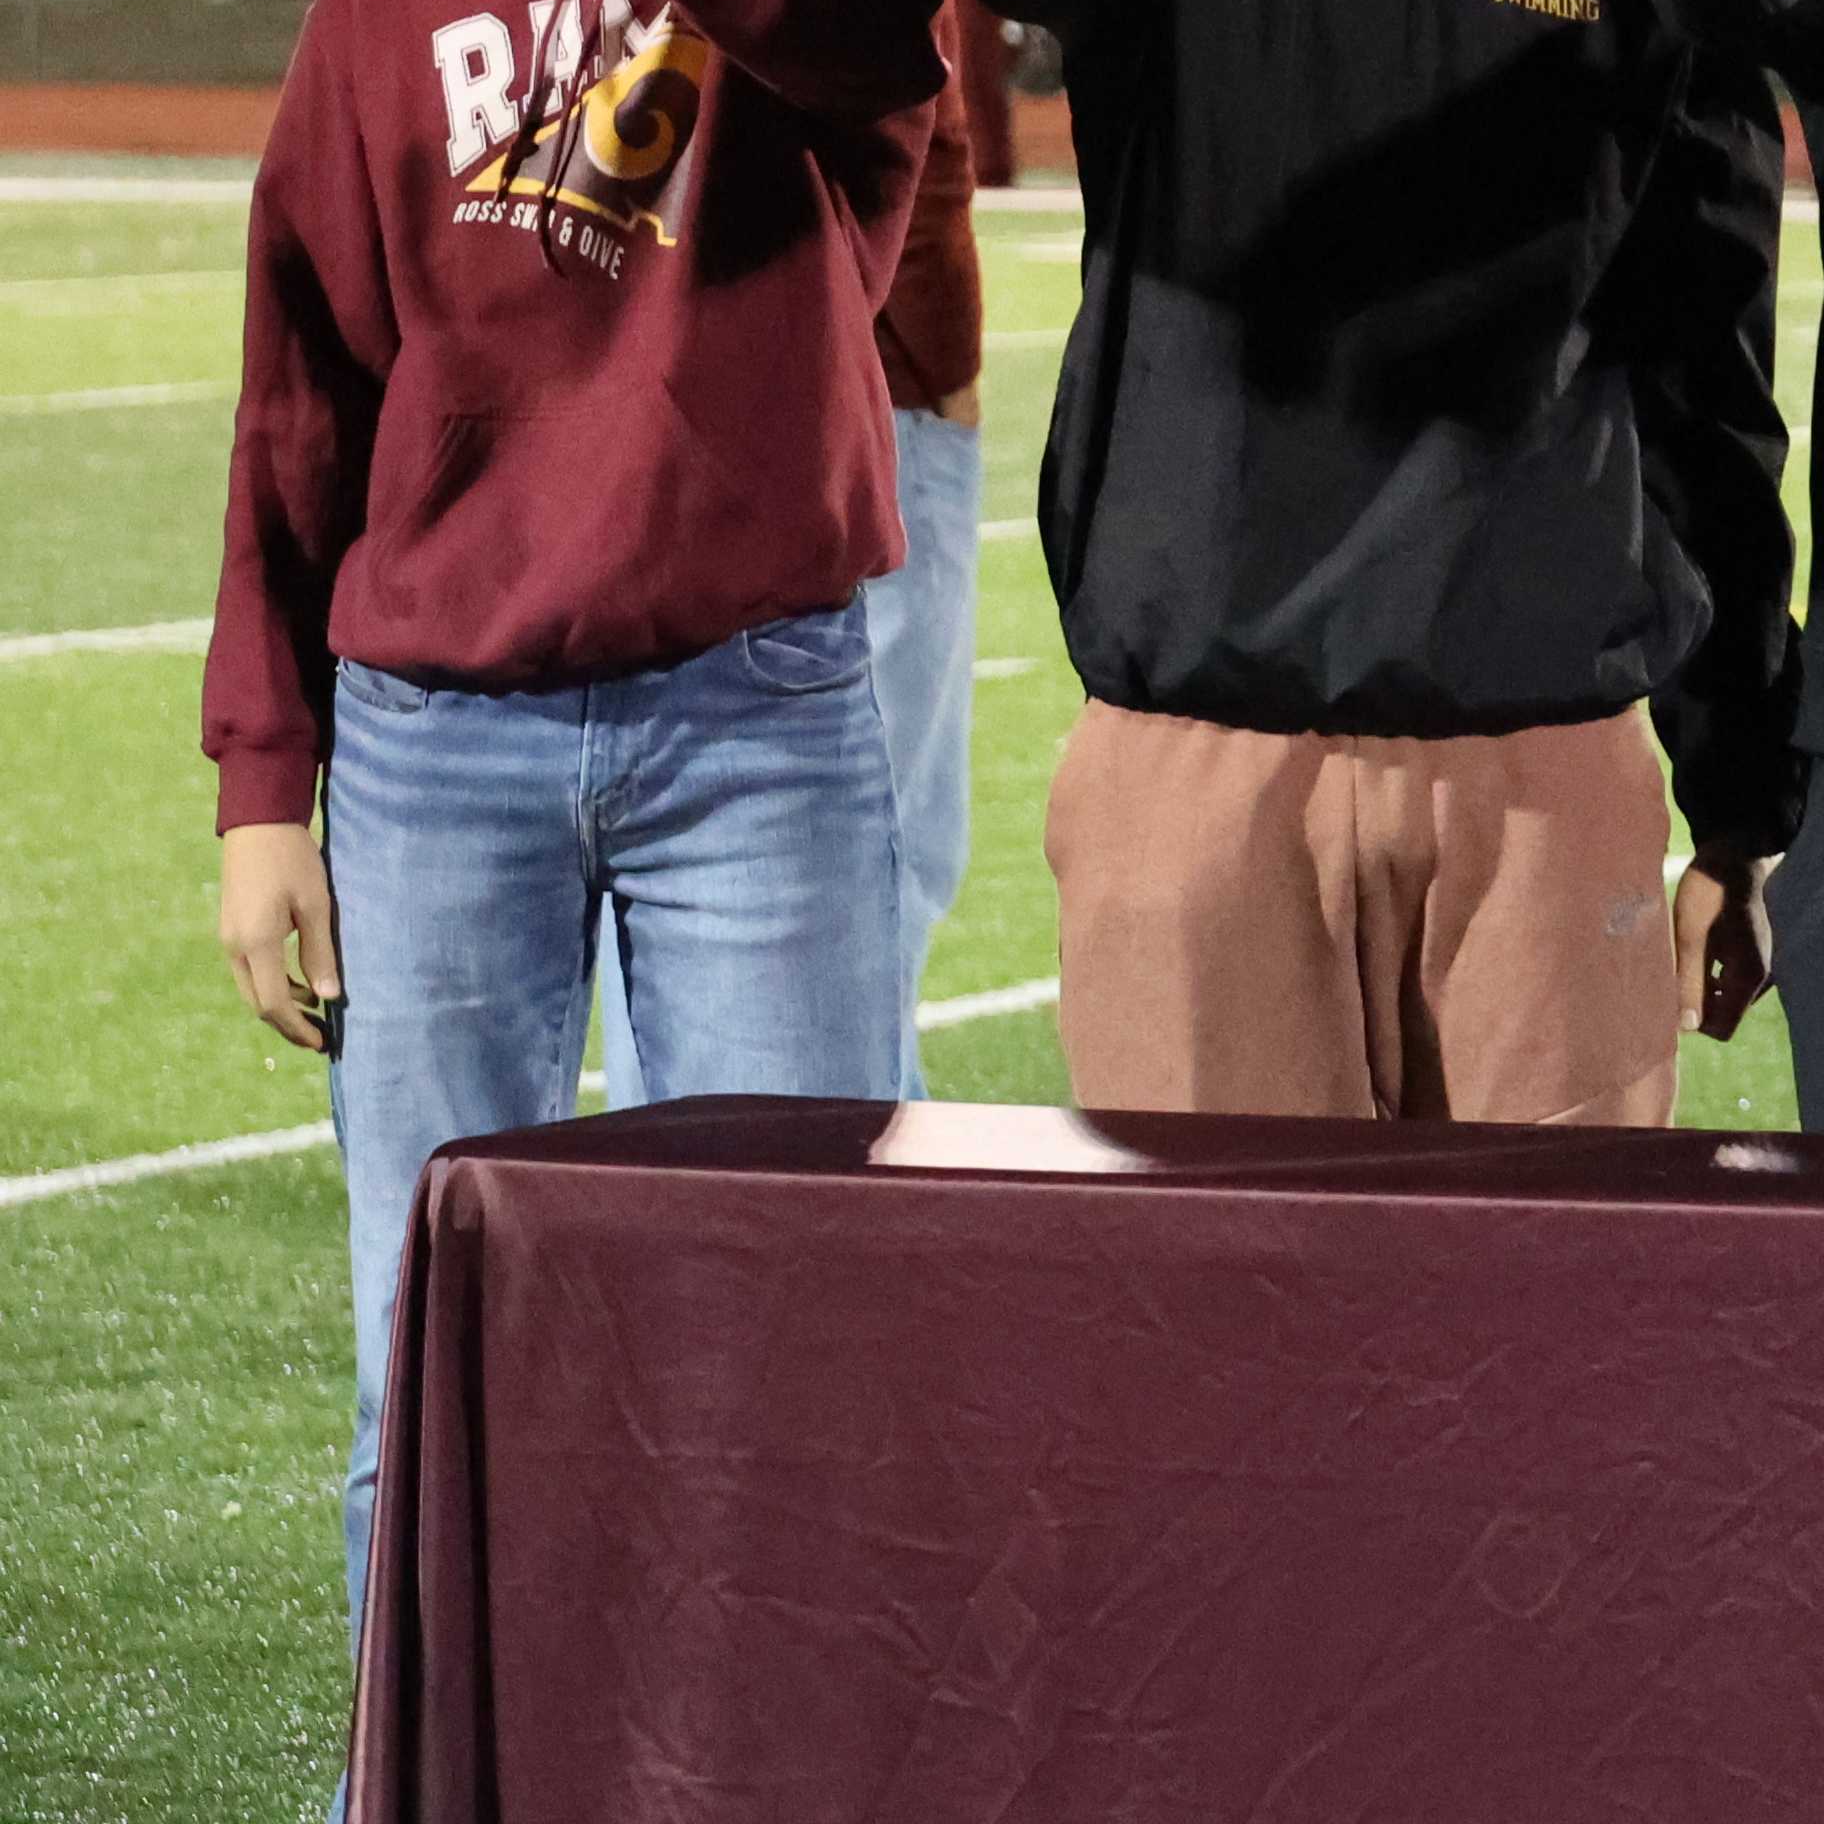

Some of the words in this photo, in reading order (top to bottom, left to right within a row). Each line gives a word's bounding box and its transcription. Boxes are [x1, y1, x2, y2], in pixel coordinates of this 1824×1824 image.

[452, 200, 506, 224] ROSS
[559, 216, 574, 246] &
[578, 224, 625, 280] DIVE
